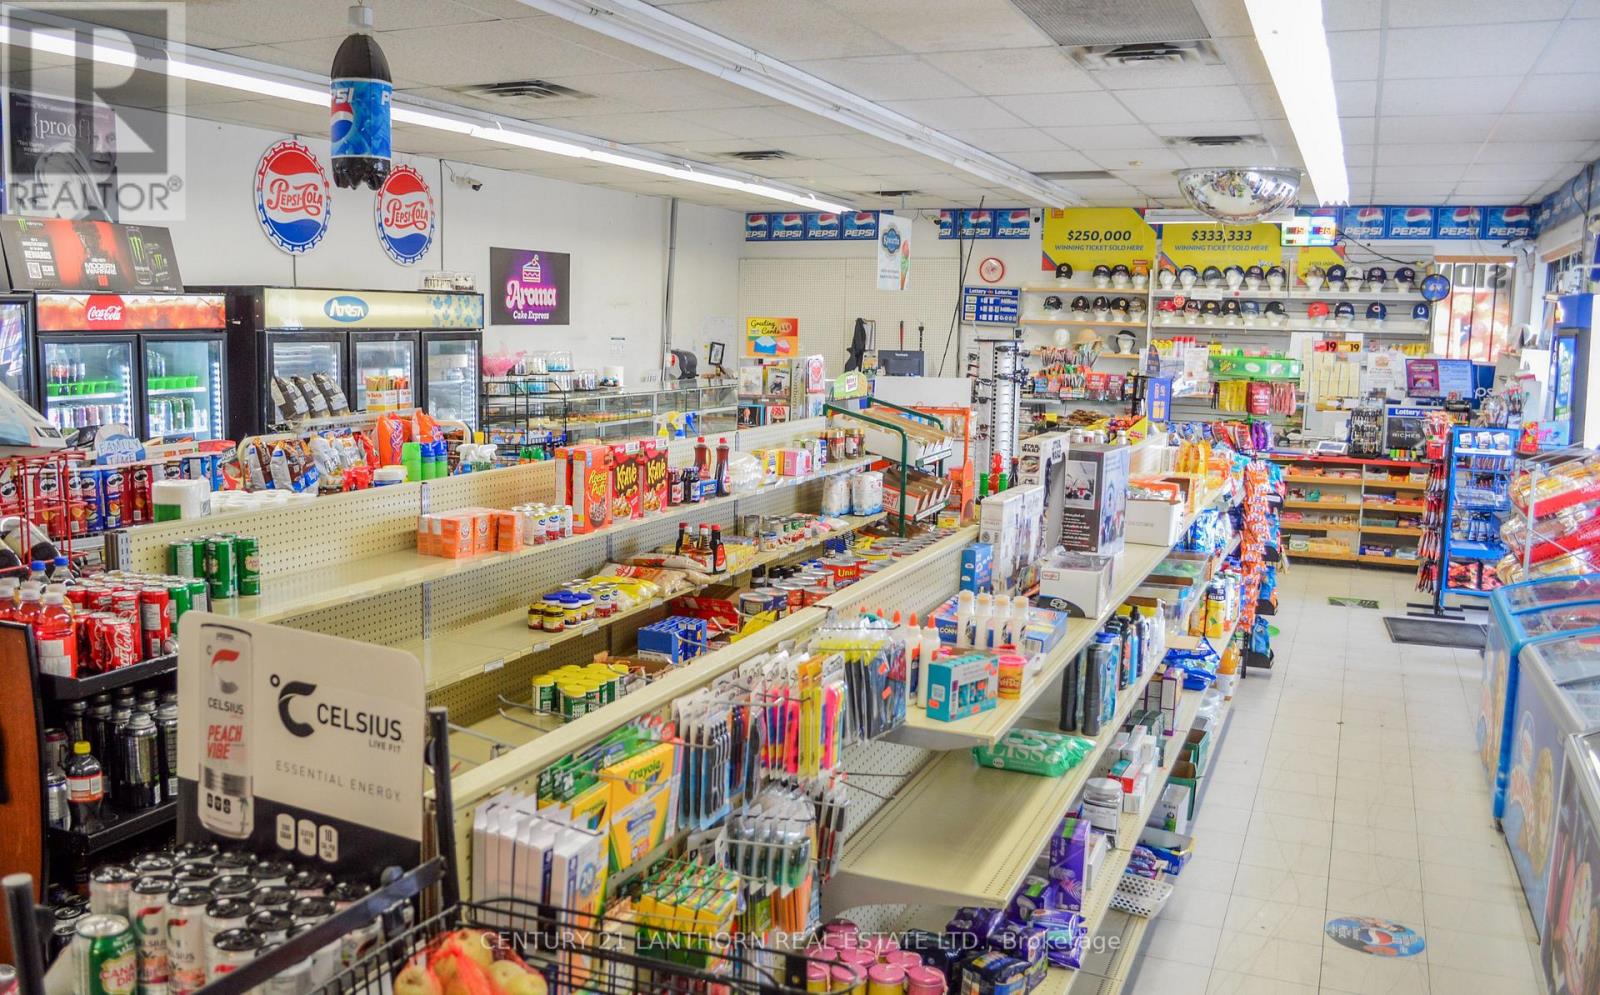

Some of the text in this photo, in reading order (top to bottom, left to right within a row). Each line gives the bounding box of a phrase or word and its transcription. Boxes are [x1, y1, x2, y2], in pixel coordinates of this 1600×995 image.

[746, 231, 767, 239] EPSI
[772, 230, 802, 239] PEPSI
[808, 229, 838, 238] PEPSI
[844, 229, 875, 237] PEPSI
[959, 228, 991, 236] PEPSI
[998, 228, 1030, 236] PEPSI
[1067, 230, 1132, 243] $250,000
[1192, 230, 1253, 243] $333,333
[1345, 226, 1383, 236] PEPSI
[1391, 226, 1431, 236] PEPSI
[1439, 227, 1479, 236] PEPSI
[1488, 227, 1529, 236] PEPSI
[505, 280, 556, 309] Aroma
[513, 311, 550, 321] Cake Express
[750, 319, 776, 330] Greeting
[1325, 341, 1337, 352] 19
[1350, 343, 1360, 352] 19
[1395, 409, 1421, 417] Lottery
[616, 463, 637, 490] Krave
[647, 459, 666, 484] Krave
[940, 627, 957, 635] CONN
[207, 697, 244, 715] CELSIUS
[316, 703, 402, 741] CELSIUS
[207, 724, 243, 742] PEACH
[207, 741, 231, 760] VIBE
[368, 740, 401, 754] LIVE FIT
[628, 759, 661, 780] Crayola
[275, 760, 402, 803] ESSENTIAL ENERGY
[117, 972, 136, 987] DR
